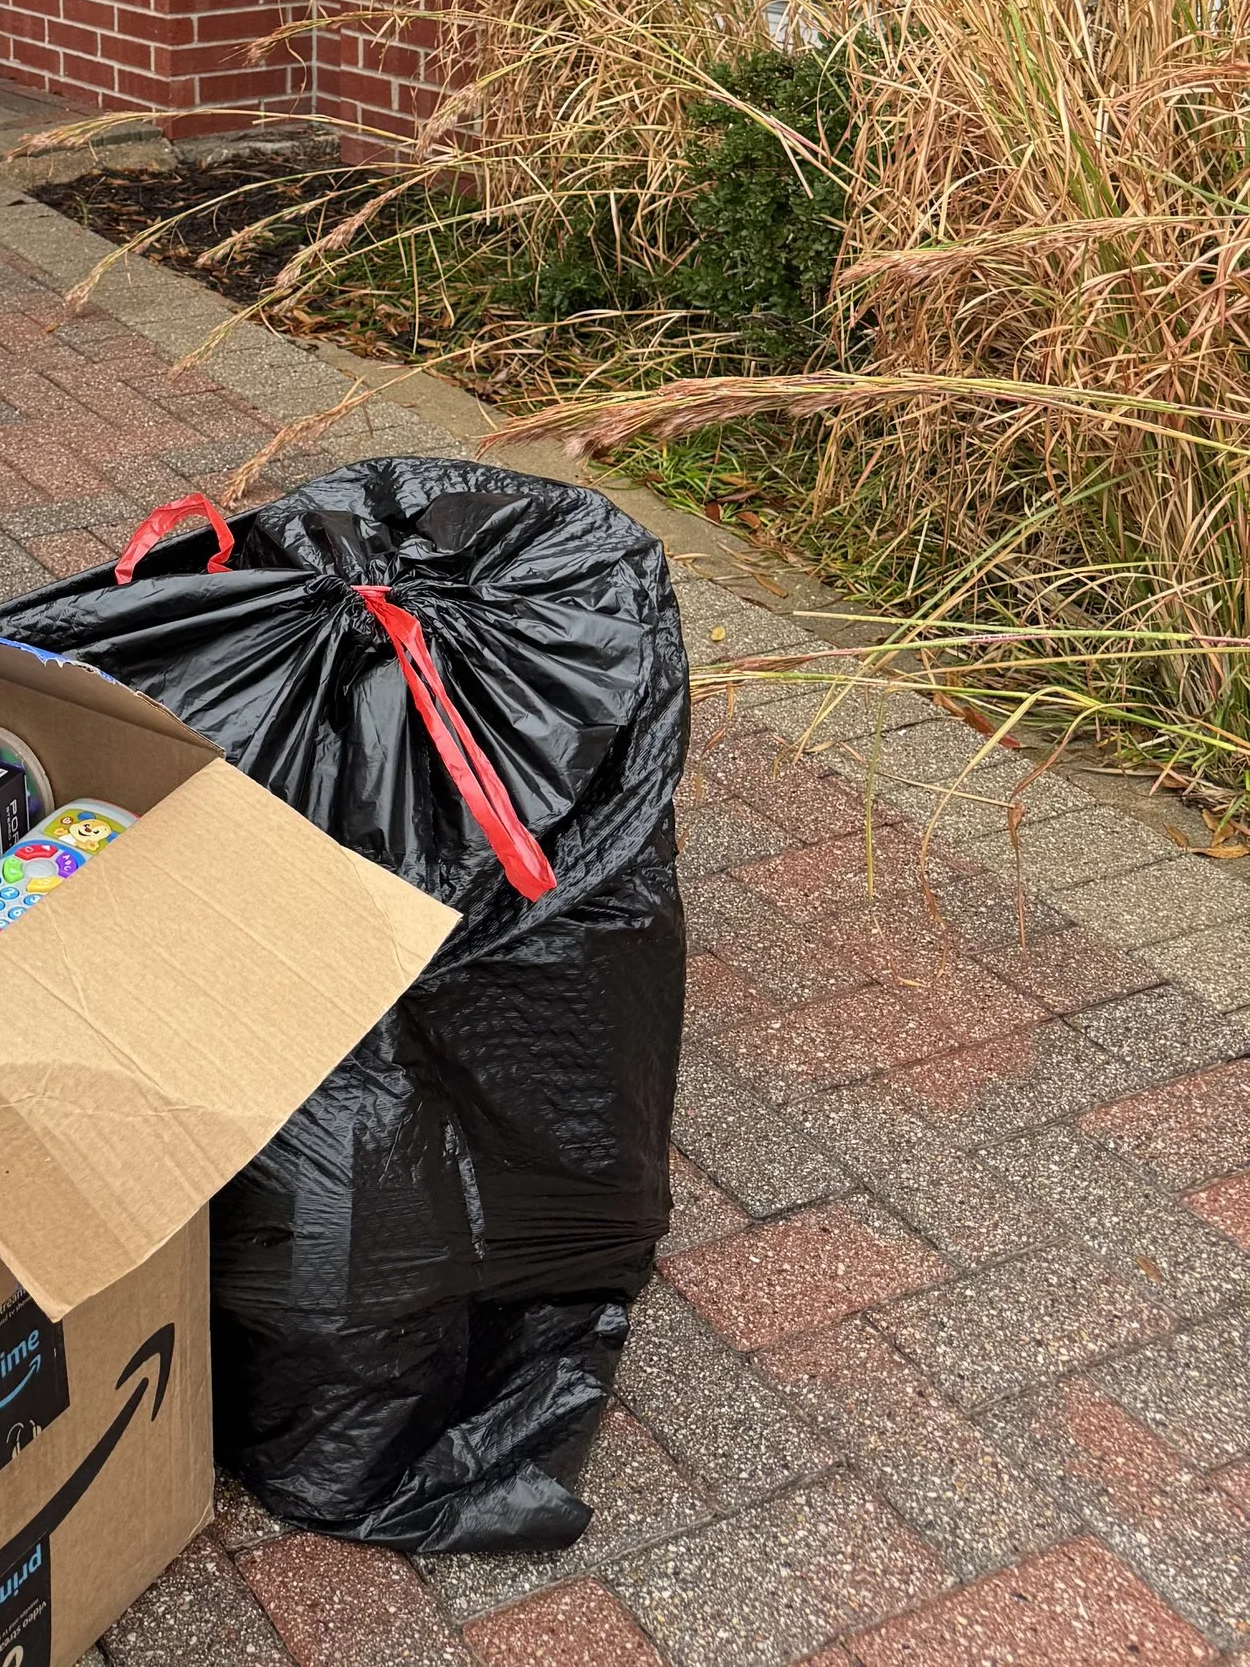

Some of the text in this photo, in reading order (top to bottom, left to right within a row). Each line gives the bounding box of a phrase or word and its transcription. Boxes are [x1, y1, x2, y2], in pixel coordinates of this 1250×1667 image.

[62, 853, 72, 871] ABC
[3, 889, 14, 897] 2
[31, 895, 42, 903] 3
[15, 907, 23, 917] 6
[22, 1601, 47, 1628] video
